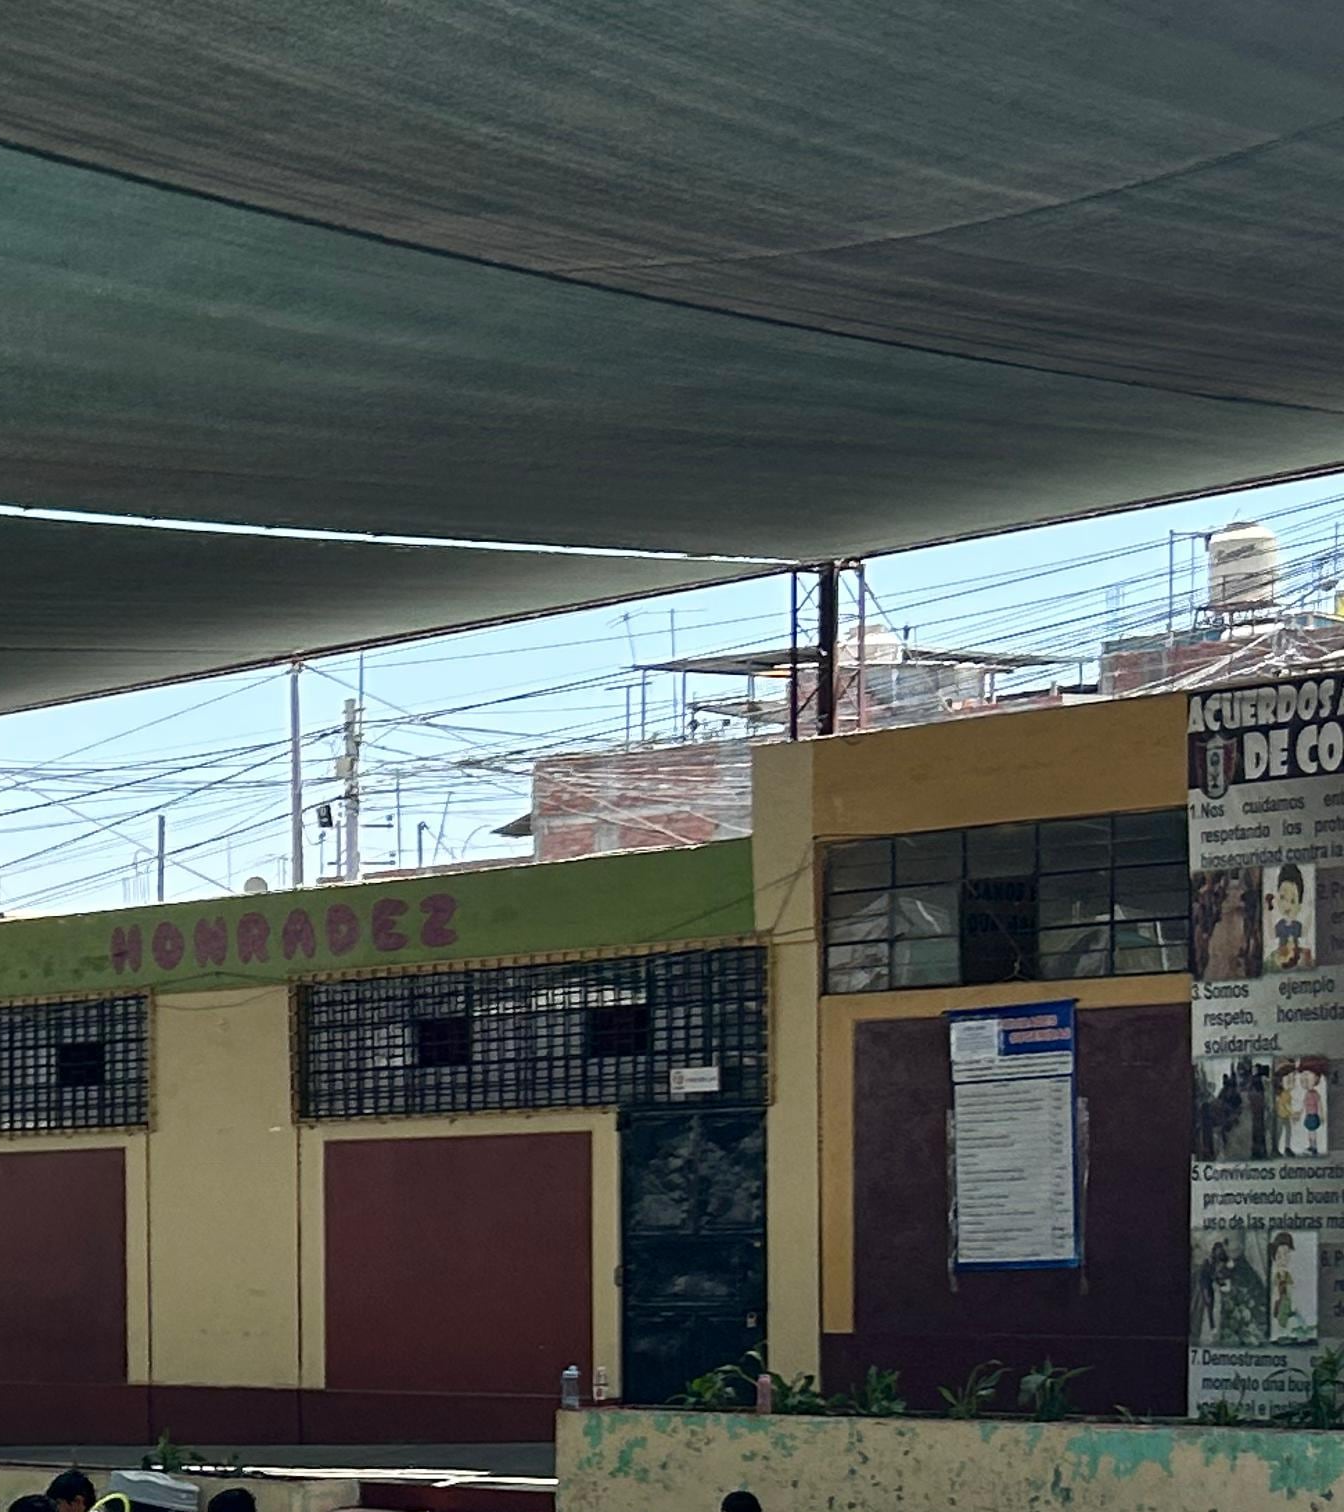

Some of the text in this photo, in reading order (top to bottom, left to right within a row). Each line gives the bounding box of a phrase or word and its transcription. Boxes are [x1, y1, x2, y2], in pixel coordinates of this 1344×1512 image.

[1187, 678, 1334, 732] ACUERDOS
[1243, 728, 1289, 780] DE
[1242, 796, 1305, 815] cuidamos
[1201, 822, 1270, 845] respetando
[1282, 818, 1303, 836] los
[1200, 848, 1282, 868] bioseguridad
[1286, 844, 1328, 862] contra
[111, 893, 458, 976] HONRADEZ
[1279, 976, 1334, 1000] ejemplo
[1203, 1010, 1256, 1029] respeto,
[1204, 1033, 1281, 1053] solidaridad.
[1203, 1188, 1284, 1209] promoviendo
[1287, 1191, 1303, 1204] un
[1305, 1187, 1338, 1204] buen
[1203, 1216, 1227, 1230] uso
[1229, 1214, 1245, 1230] de
[1247, 1213, 1265, 1230] las
[1267, 1212, 1322, 1232] palabras
[1202, 1349, 1287, 1367] Demostramos
